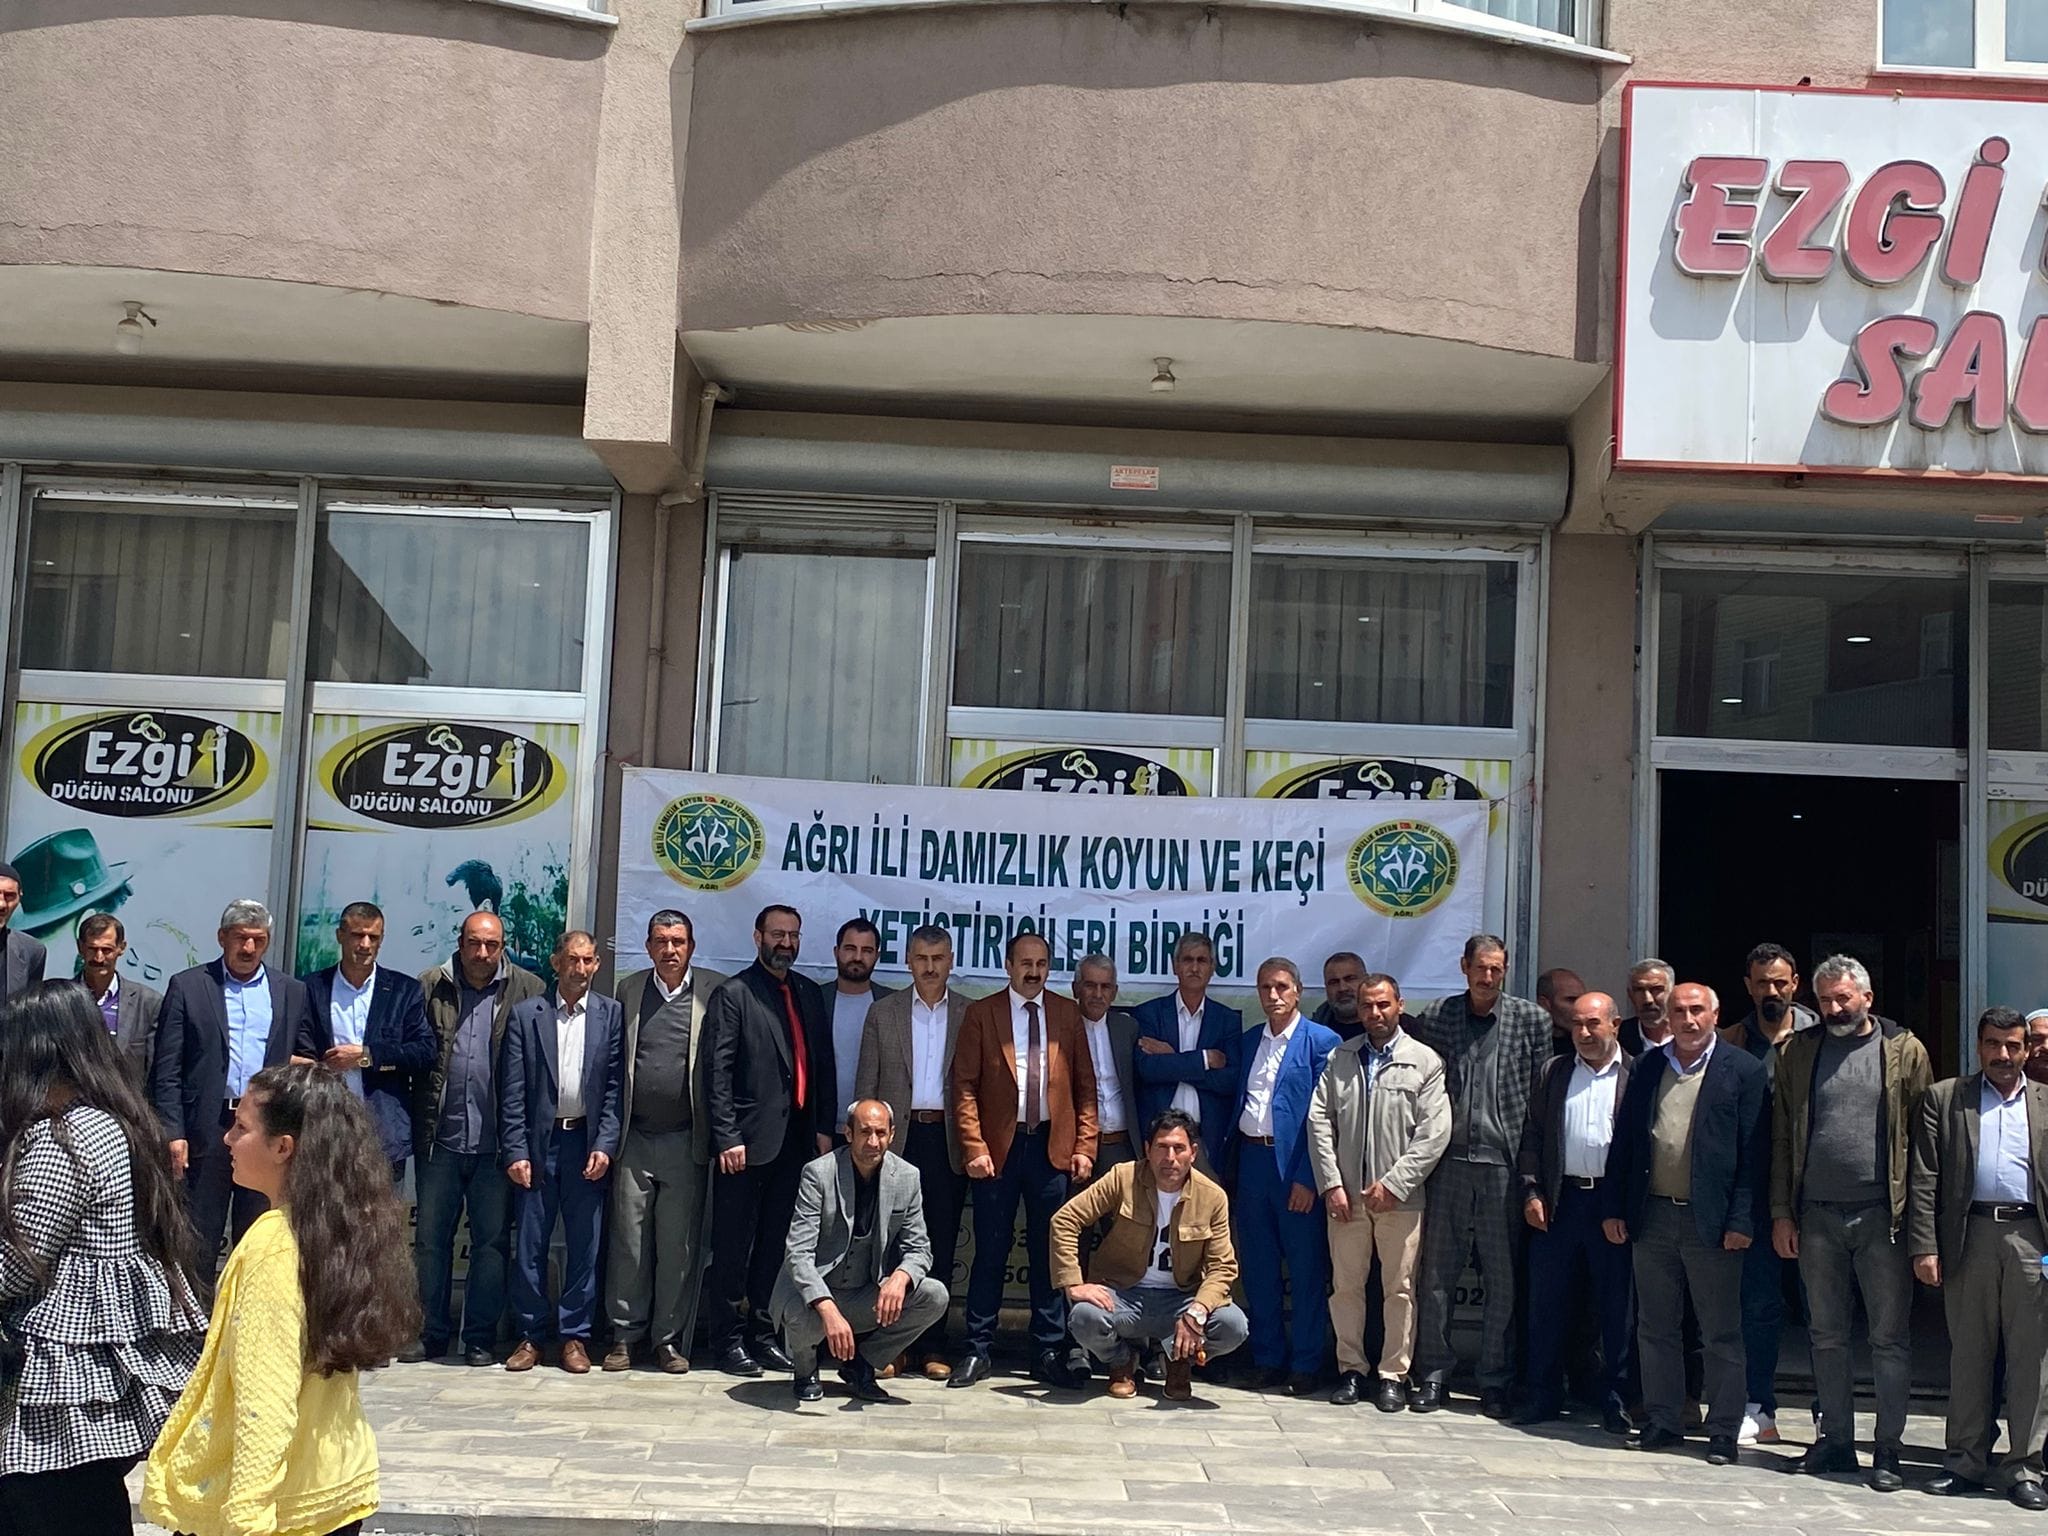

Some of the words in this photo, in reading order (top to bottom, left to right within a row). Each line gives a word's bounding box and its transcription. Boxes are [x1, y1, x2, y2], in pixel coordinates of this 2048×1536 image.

[1674, 136, 2010, 288] EZGİ
[85, 731, 195, 787] Ezgi
[383, 742, 493, 798] Ezgi
[51, 780, 116, 802] DÜĞÜN
[119, 787, 194, 804] SALONU
[350, 791, 415, 813] DÜĞÜN
[418, 798, 492, 816] SALONU
[782, 809, 860, 874] AĞRI
[870, 812, 910, 878] İLİ
[920, 829, 1070, 887] DAMIZLIK
[1080, 836, 1189, 891] KOYUN
[1200, 839, 1240, 893] VE
[1251, 827, 1325, 907] KEÇİ
[1129, 907, 1244, 978] BİRĞİ
